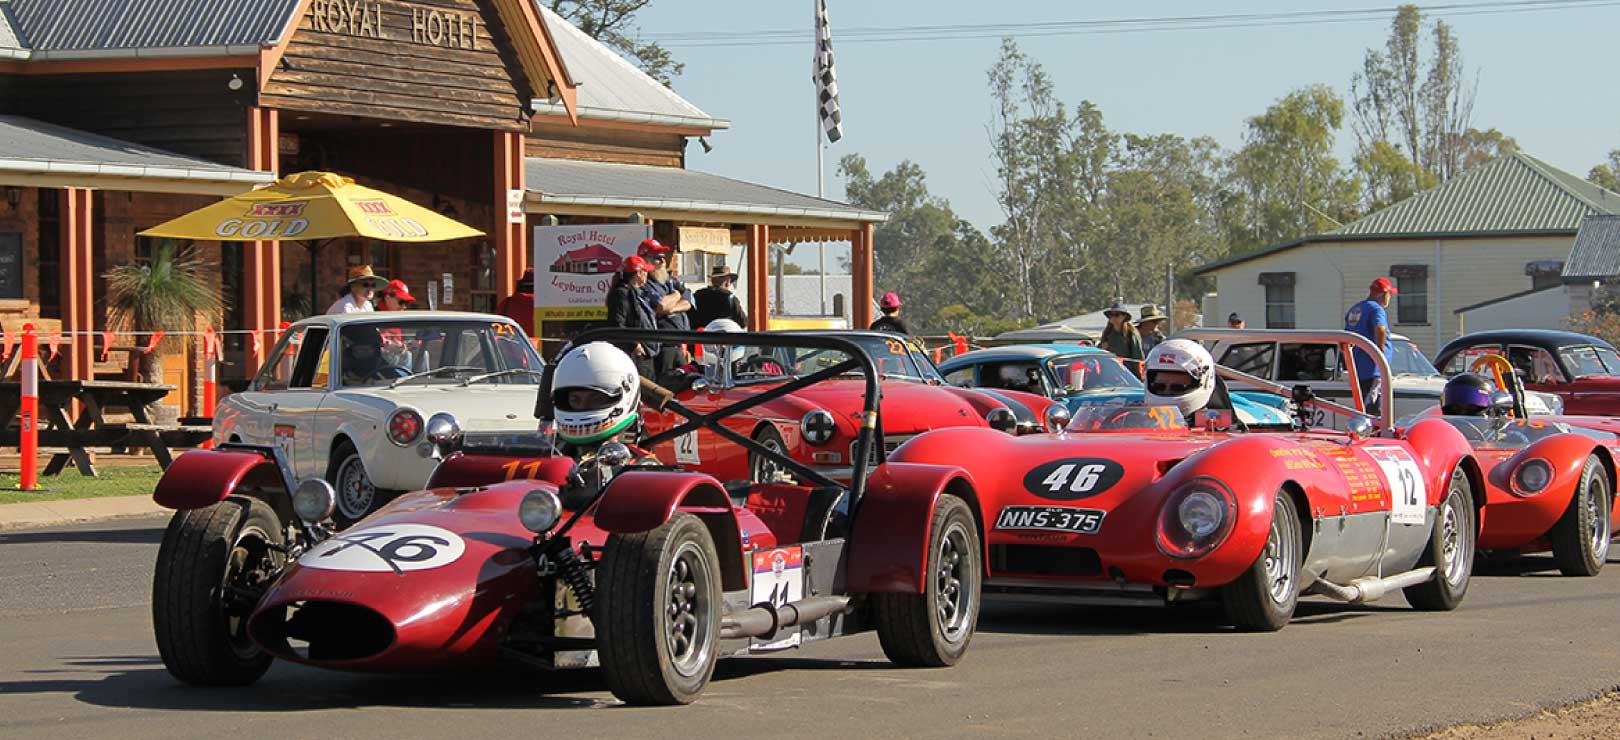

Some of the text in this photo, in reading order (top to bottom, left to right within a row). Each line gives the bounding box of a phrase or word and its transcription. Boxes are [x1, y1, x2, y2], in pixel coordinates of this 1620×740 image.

[312, 0, 483, 51] ROYAL HOTEL
[250, 202, 302, 216] XXXX
[353, 200, 393, 215] XXXX
[215, 217, 310, 238] GOLD
[557, 230, 617, 246] Royal Hotel
[490, 322, 516, 336] 21
[884, 339, 908, 356] 22
[1148, 405, 1181, 431] 12
[680, 432, 693, 454] 22
[502, 460, 542, 481] 11
[1041, 463, 1106, 492] 46
[1398, 467, 1417, 506] 12
